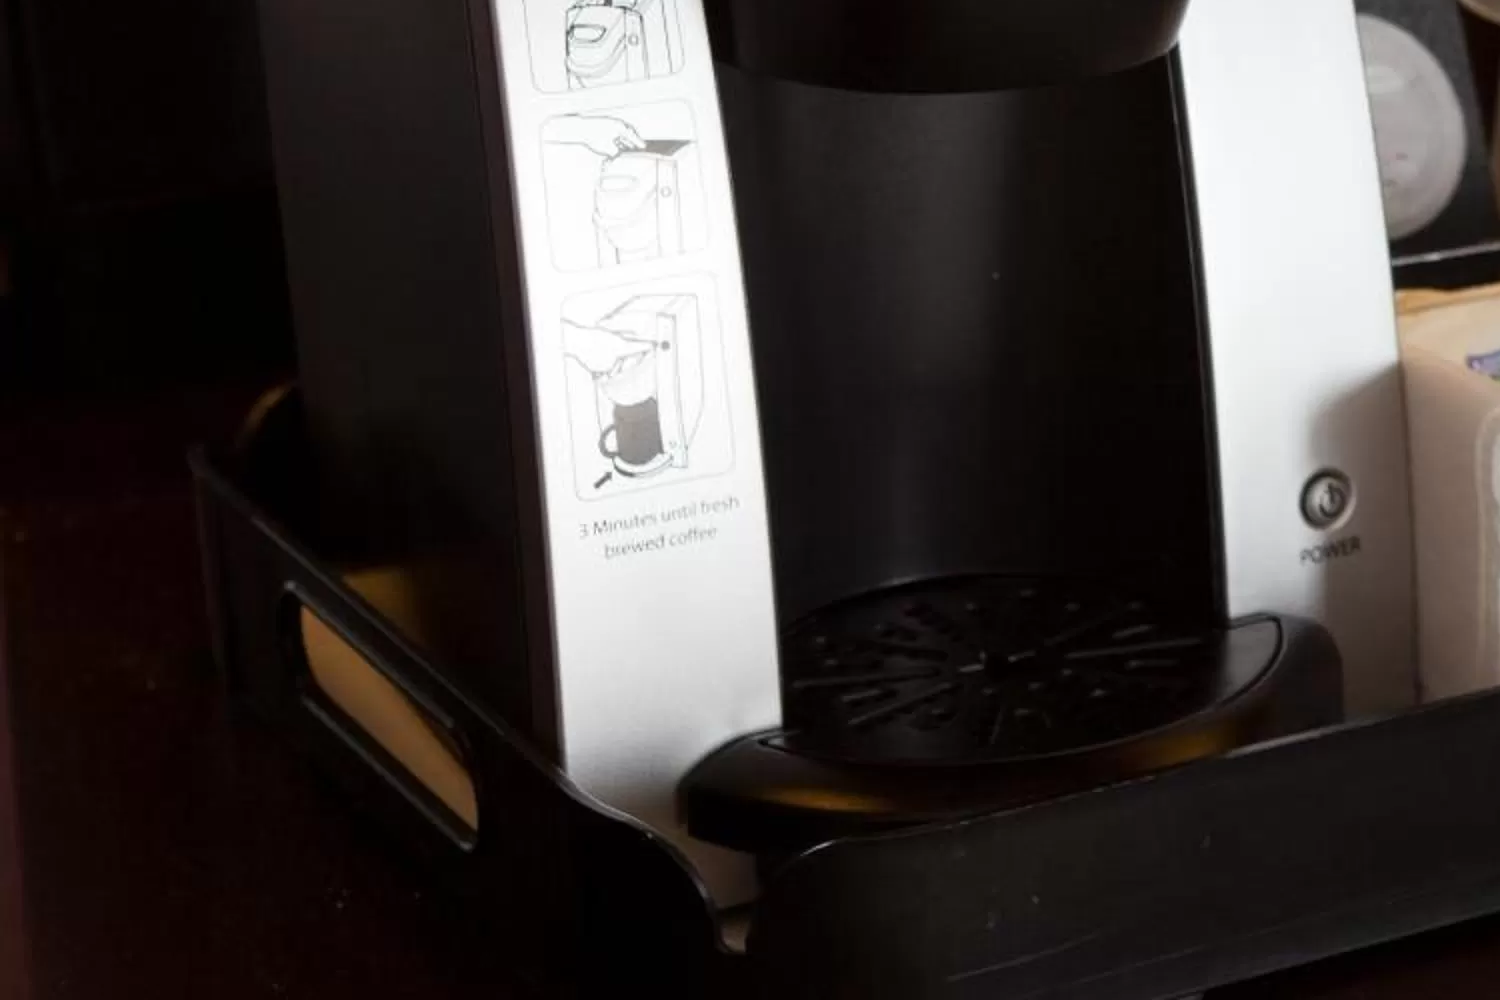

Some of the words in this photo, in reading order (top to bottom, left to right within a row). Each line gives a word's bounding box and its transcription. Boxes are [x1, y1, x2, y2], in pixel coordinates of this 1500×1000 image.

[579, 522, 589, 539] 3
[593, 512, 658, 536] Minutes
[660, 502, 697, 523] until
[700, 495, 741, 514] fresh
[603, 534, 666, 560] brewed
[669, 525, 718, 546] coffee
[1300, 535, 1361, 566] POWER
